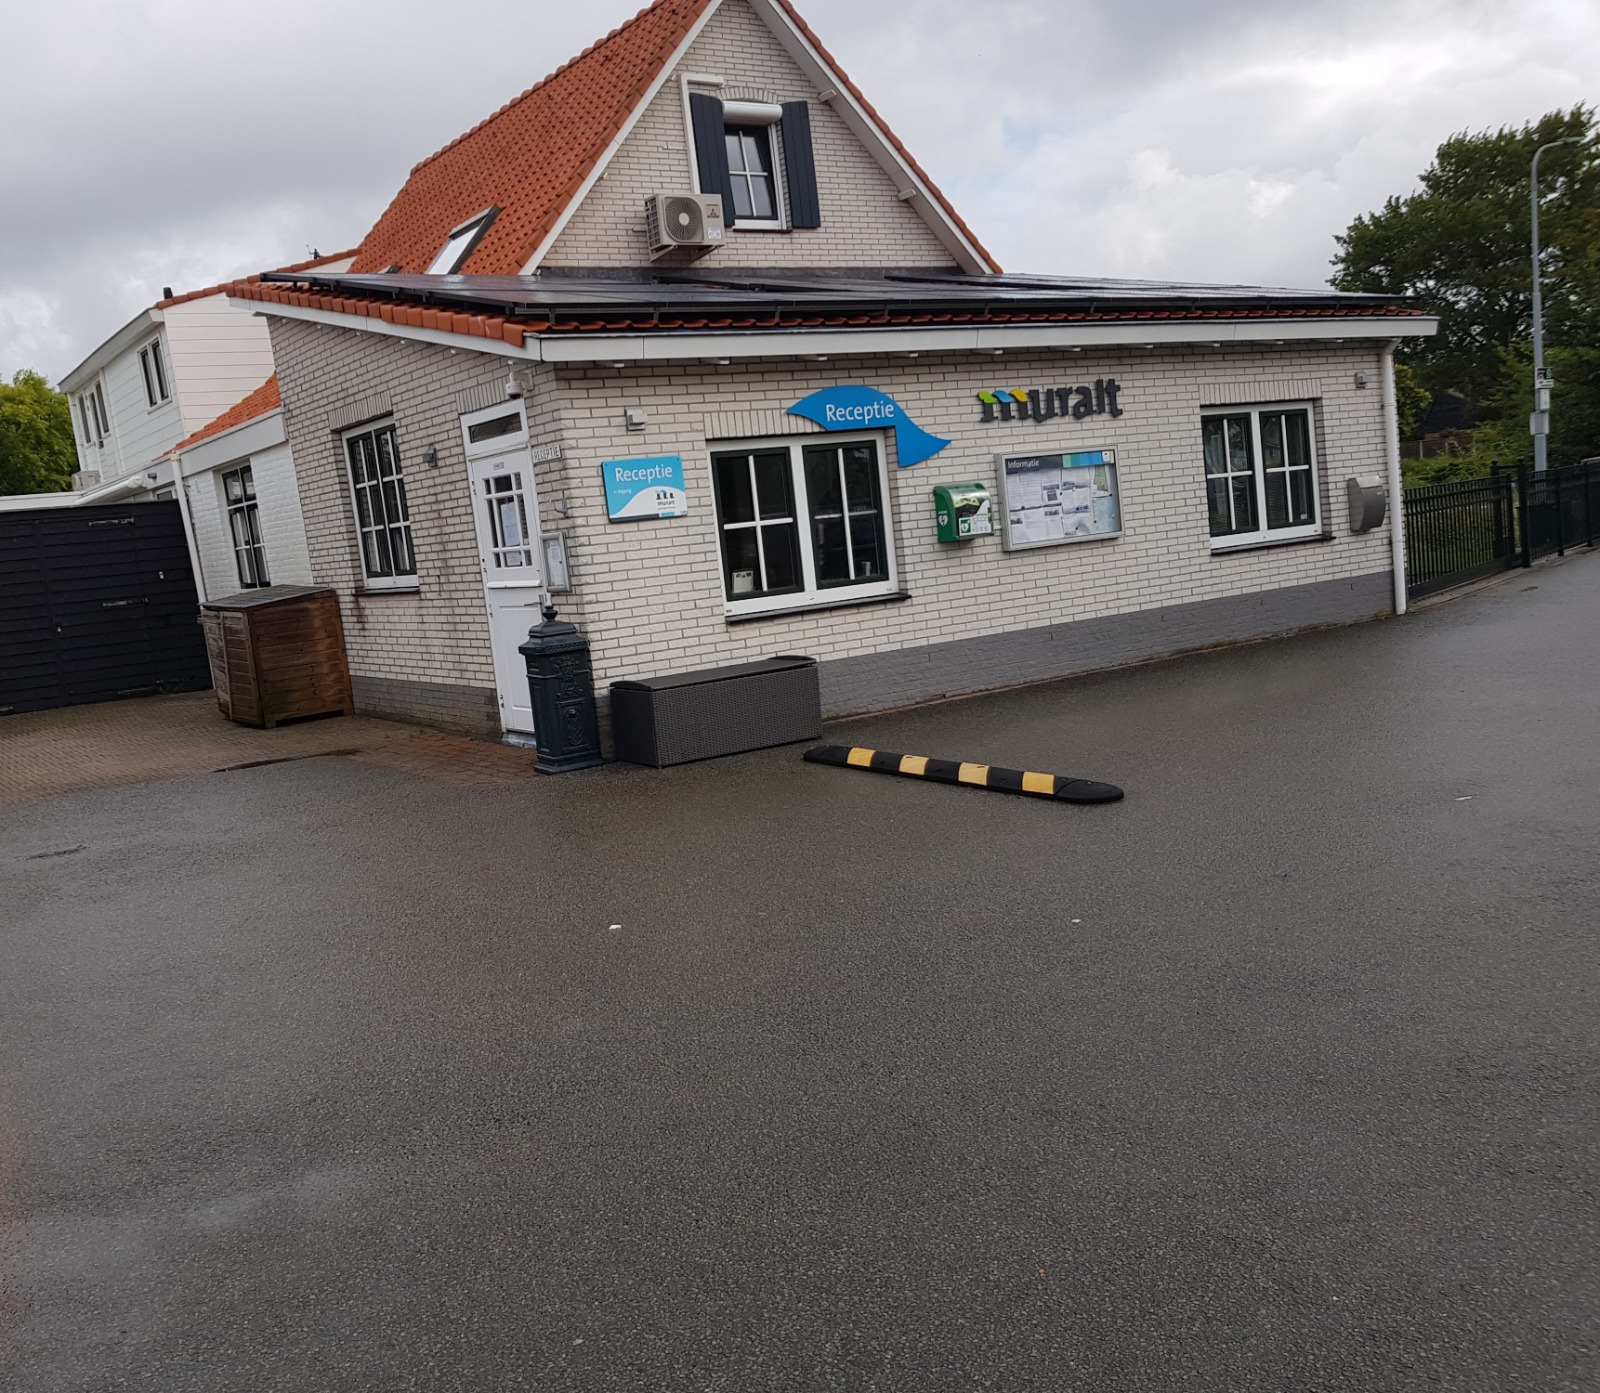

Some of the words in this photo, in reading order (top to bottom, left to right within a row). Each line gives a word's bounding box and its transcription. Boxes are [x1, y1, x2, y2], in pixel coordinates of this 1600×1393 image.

[977, 378, 1123, 423] muralt
[825, 400, 895, 425] Receptie
[533, 446, 560, 461] RECEPTIE
[615, 464, 673, 484] Receptie
[1007, 459, 1040, 470] Informatie
